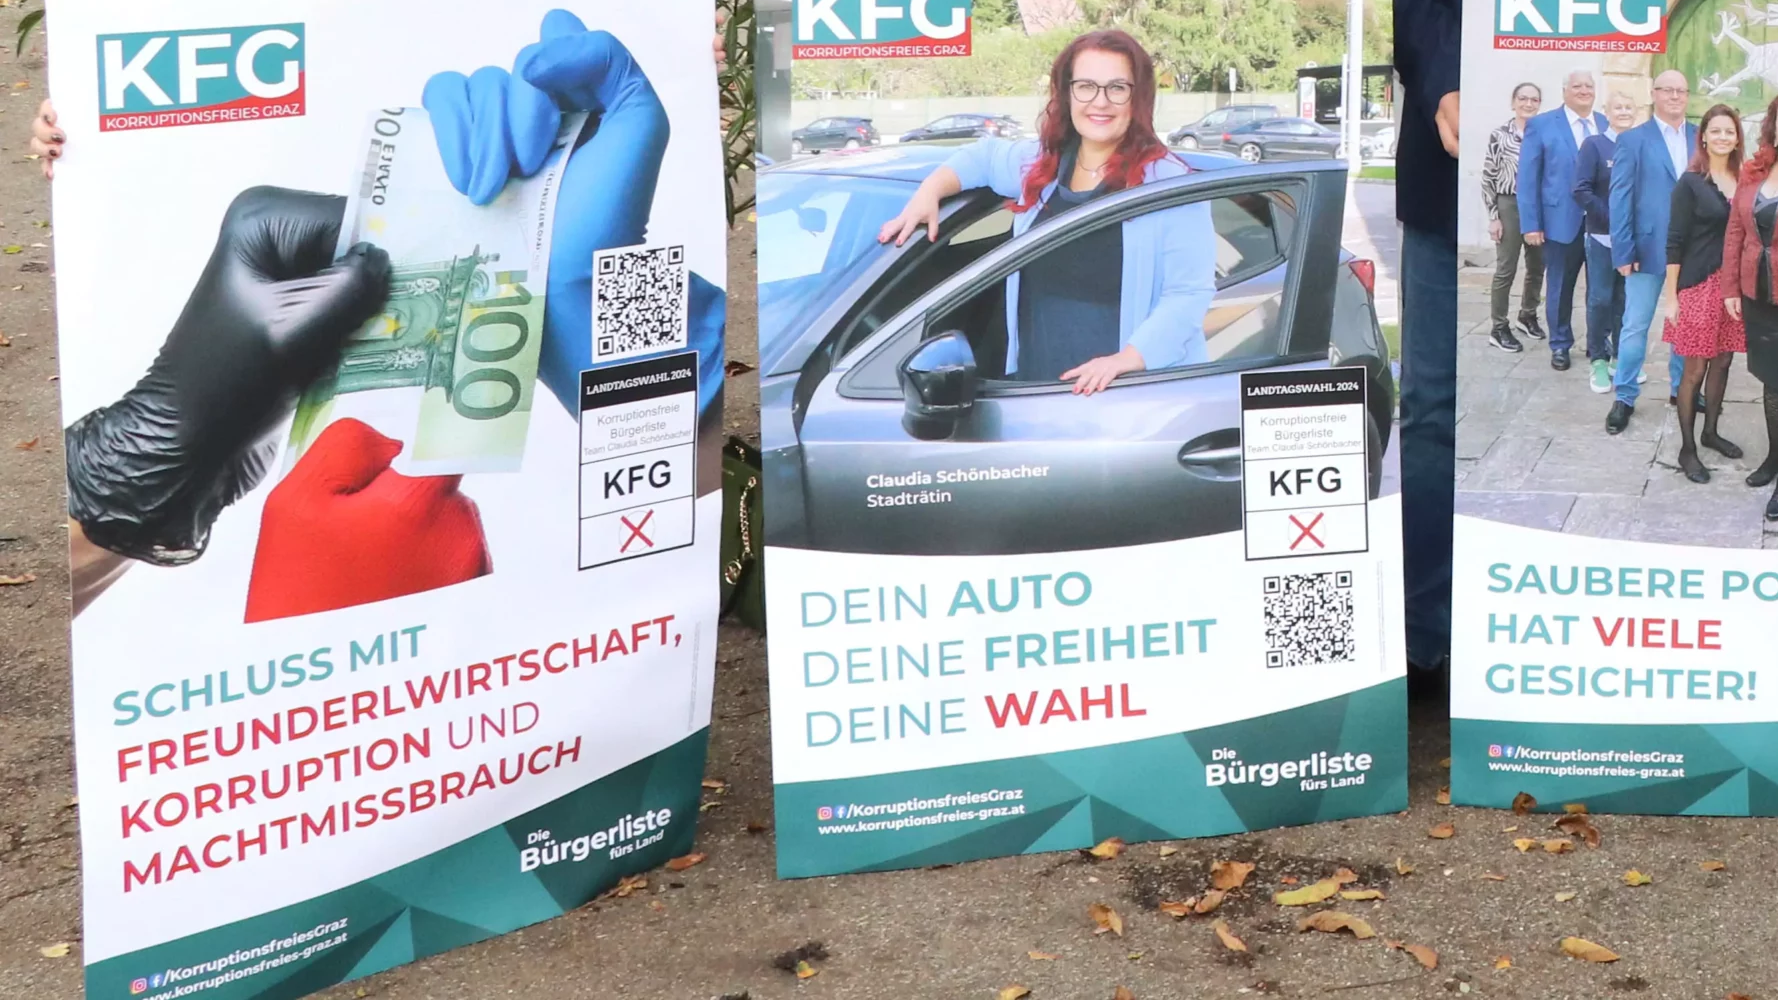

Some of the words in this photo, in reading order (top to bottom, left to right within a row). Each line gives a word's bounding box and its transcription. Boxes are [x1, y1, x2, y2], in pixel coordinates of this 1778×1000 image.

[797, 45, 931, 59] KORRUPTIONSFREIES
[933, 44, 967, 57] GRAZ
[1499, 37, 1626, 51] KORRUPTIONSFREIES
[1628, 40, 1661, 53] GRAZ
[102, 28, 300, 110] KFG
[105, 107, 258, 130] KORRUPTIONSFREIES
[261, 102, 301, 118] GRAZ
[586, 374, 670, 395] LANDTAGSWAHL
[671, 368, 692, 381] 2024
[1247, 383, 1335, 396] LANDTAGSWAHL
[1337, 382, 1359, 392] 2024
[597, 403, 681, 427] Korruptionsfreie
[610, 420, 667, 440] Bürgerliste
[1260, 412, 1347, 427] Korruptionsfreie
[584, 445, 605, 457] Team
[607, 439, 638, 452] Claudia
[640, 429, 692, 446] Schönbacher
[1247, 445, 1269, 454] Team
[1272, 443, 1304, 453] Claudia
[1307, 439, 1361, 450] Schönbacher
[1274, 429, 1334, 442] Bürgerliste
[604, 460, 672, 499] KFG
[866, 472, 932, 490] Claudia
[936, 462, 1050, 484] Schönbacher
[1269, 466, 1342, 497] KFG
[866, 489, 952, 509] Stadträtin
[1486, 562, 1705, 600] SAUBERE
[801, 585, 928, 628] DEIN
[946, 571, 1092, 617] AUTO
[1487, 612, 1580, 645] HAT
[1592, 615, 1722, 650] VIELE
[803, 640, 966, 688] DEINE
[984, 618, 1217, 672] FREIHEIT
[112, 647, 334, 728] SCHLUSS
[348, 624, 428, 673] MIT
[1485, 662, 1757, 701] GESICHTER!
[117, 614, 683, 783] FREUNDERLWIRTSCHAFT,
[805, 699, 966, 747] DEINE
[984, 682, 1147, 729] WAHL
[120, 728, 431, 839] KORRUPTION
[448, 700, 540, 751] UND
[1205, 750, 1373, 787] Bürgerliste
[1212, 748, 1236, 761] Die
[1513, 746, 1684, 765] /KorruptionsfreiesGraz
[1300, 776, 1326, 791] fürs
[1330, 773, 1365, 788] Land
[1488, 761, 1685, 779] www.korruptionsfreies-graz.at
[122, 735, 582, 893] MACHTMISSBRAUCH
[845, 787, 1024, 819] /KorruptionsfreiesGraz
[818, 804, 1025, 836] www.korruptionsfreies-graz.at
[520, 805, 673, 873] Bürgerliste
[528, 828, 551, 845] Die
[609, 842, 633, 861] fürs
[635, 831, 665, 855] Land
[141, 932, 348, 1000] ww.korruptionsfreies-graz.at
[162, 917, 349, 987] /KorruptionsfreiesGraz
